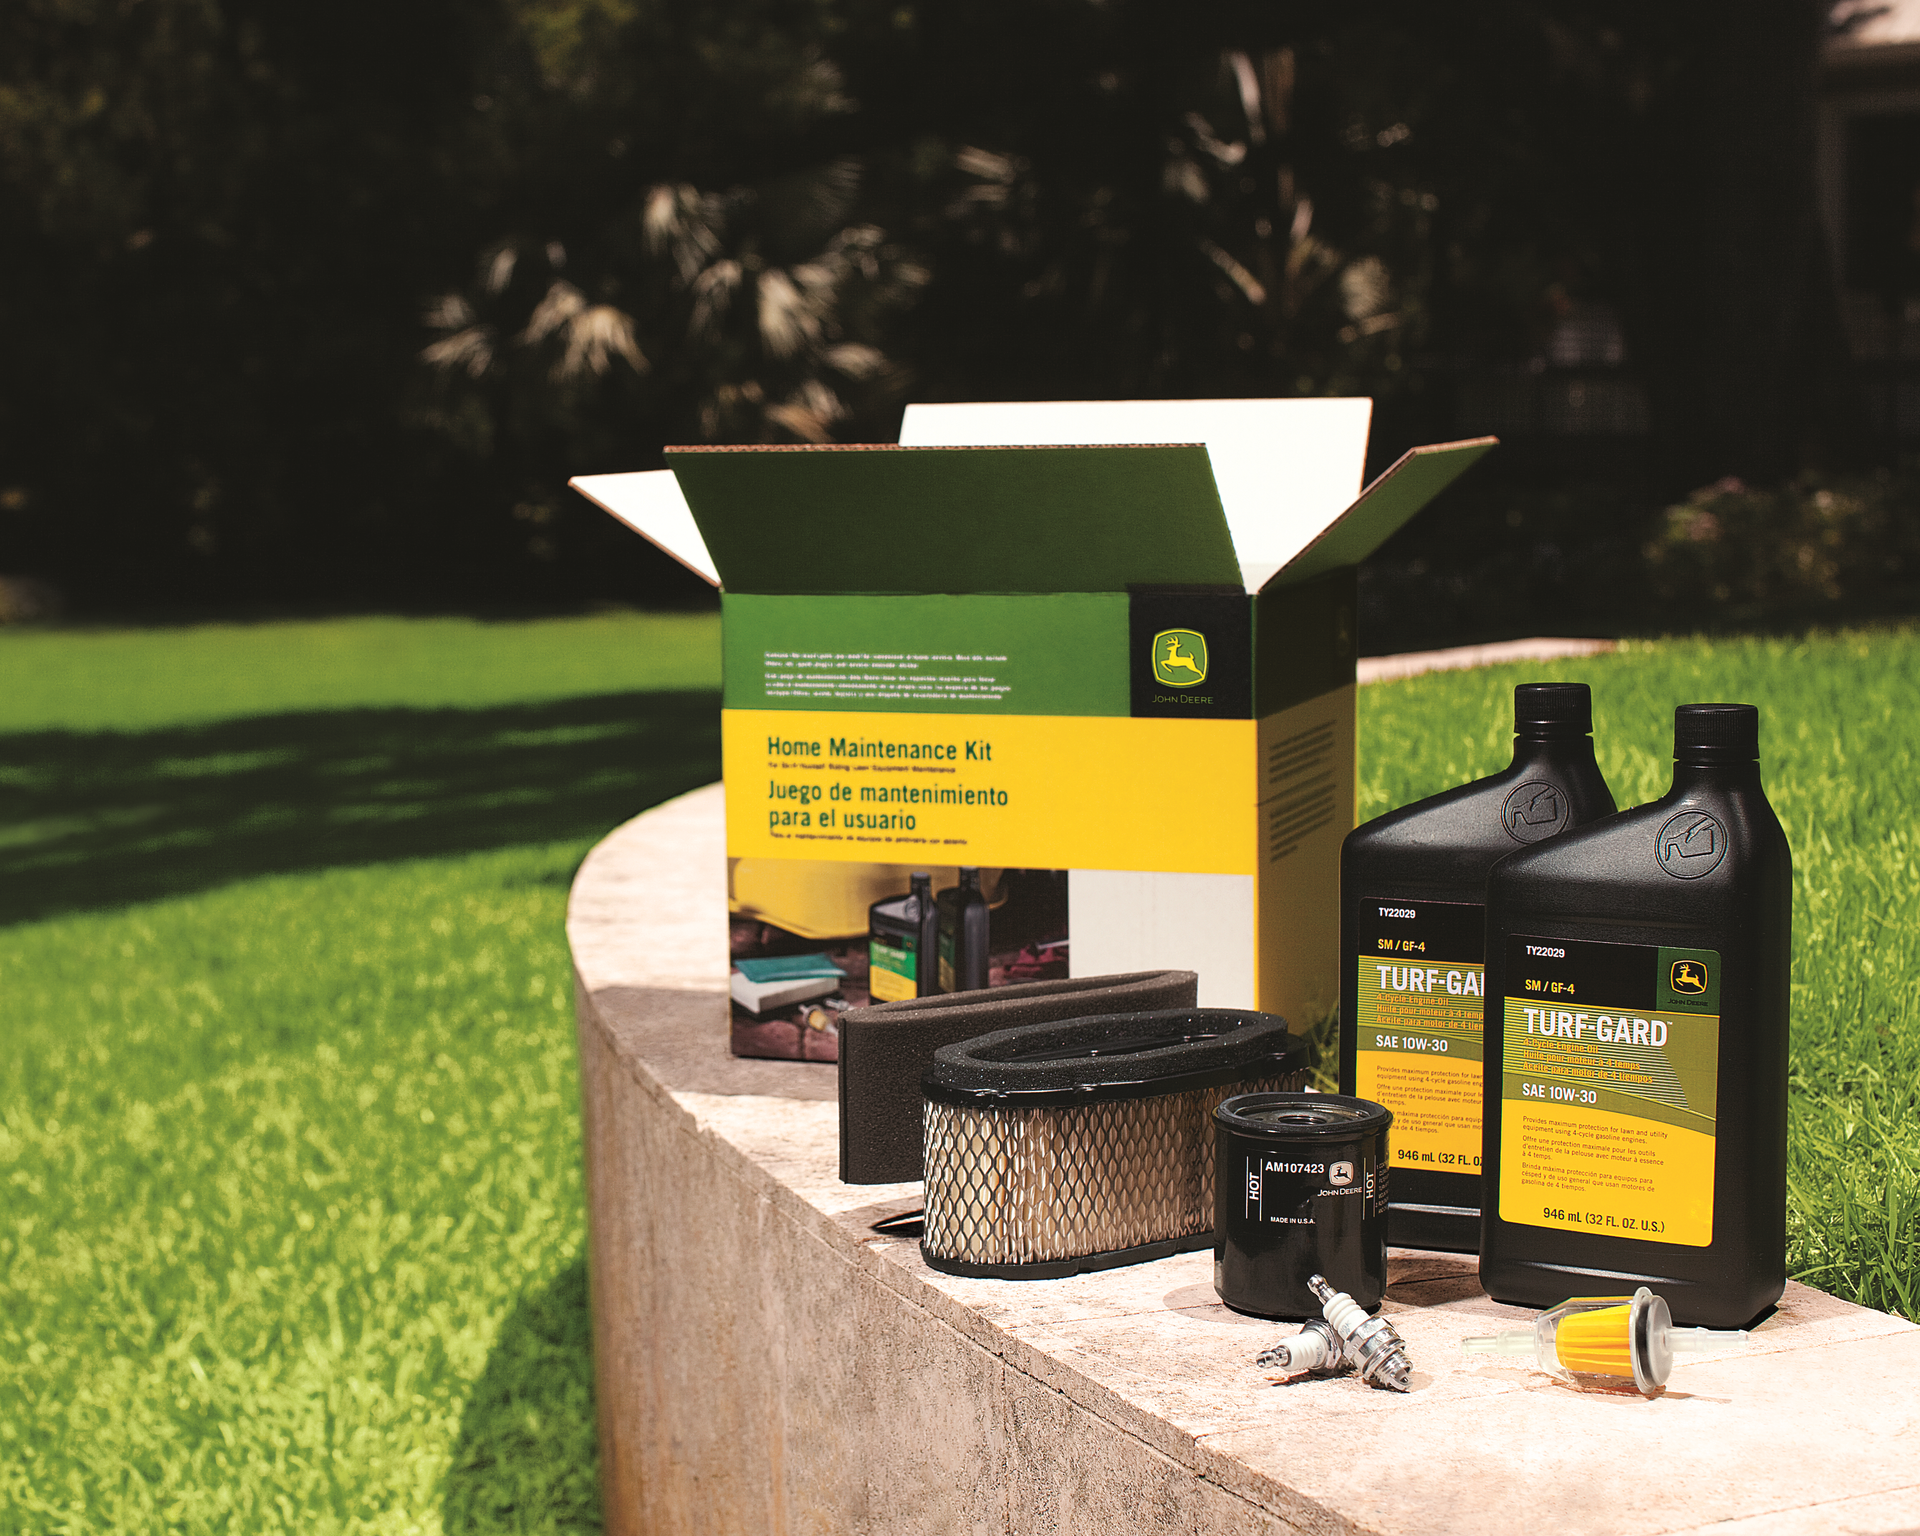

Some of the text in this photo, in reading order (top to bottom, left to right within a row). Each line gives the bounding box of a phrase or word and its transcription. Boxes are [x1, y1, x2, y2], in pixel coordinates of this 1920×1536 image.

[1152, 694, 1214, 704] JOHN DEERE
[768, 736, 992, 760] Home Maintenance Kit
[769, 780, 1008, 806] Juego de mantenimiento
[769, 809, 916, 830] para el usuario
[1378, 908, 1416, 918] TY22029
[1378, 939, 1393, 950] SM
[1402, 941, 1425, 952] GF-4
[1526, 946, 1565, 958] TY22029
[1525, 979, 1541, 991] SM
[1551, 982, 1575, 994] GF-4
[1377, 994, 1448, 1006] 4-Cycle Engine Oil
[1376, 1004, 1397, 1012] Huile
[1400, 1006, 1416, 1015] pour
[1420, 1008, 1446, 1016] moteur
[1449, 1009, 1454, 1017] à
[1376, 1015, 1400, 1024] Aceite
[1404, 1017, 1421, 1026] para
[1422, 1019, 1446, 1027] motor
[1449, 1020, 1458, 1028] de
[1376, 1034, 1448, 1052] SAE 10W-30
[1524, 1038, 1598, 1053] 4-Cycle Engine Oil
[1524, 1050, 1640, 1070] Huile pour moteur à 4 temps
[1523, 1062, 1653, 1084] Aceite para motor de 4 tiempos
[1522, 1083, 1597, 1104] SAE 10W-30
[1523, 1116, 1547, 1124] Provides
[1650, 1131, 1668, 1139] utility
[1523, 1125, 1553, 1133] equipment
[1398, 1150, 1471, 1165] 946 mL (32 FL.
[1265, 1161, 1324, 1174] AM107423
[1522, 1162, 1540, 1170] Brinda
[1567, 1169, 1597, 1177] protección
[1249, 1172, 1260, 1200] HOT
[1317, 1187, 1362, 1197] JOHN DEERE
[1366, 1172, 1374, 1199] HOT
[1543, 1207, 1665, 1233] 946 mL (32 FL. OZ. U.S.)
